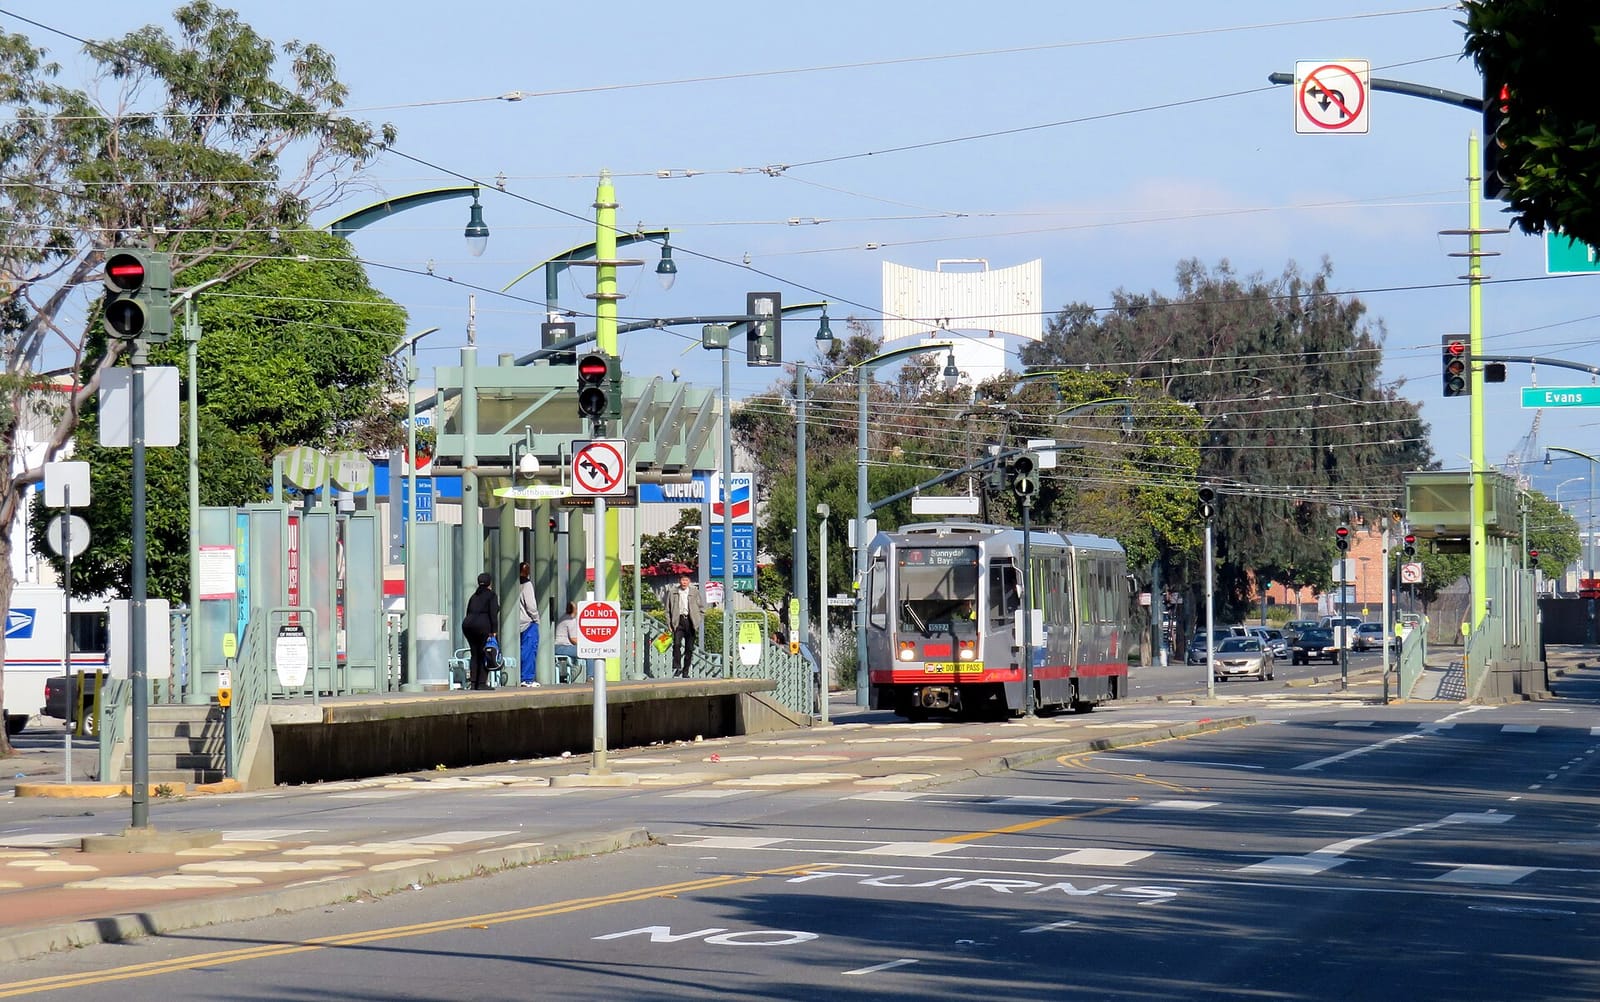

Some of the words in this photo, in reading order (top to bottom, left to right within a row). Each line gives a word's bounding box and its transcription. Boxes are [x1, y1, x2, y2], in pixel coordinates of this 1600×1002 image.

[1545, 391, 1582, 403] Evans
[664, 479, 705, 498] Chevron
[584, 609, 595, 617] DO
[598, 609, 613, 617] NOT
[586, 628, 611, 636] ENTER
[946, 664, 954, 672] DO
[955, 664, 965, 672] NOT
[966, 664, 980, 672] PASS
[785, 870, 1180, 906] TURNS
[591, 925, 820, 947] NO
